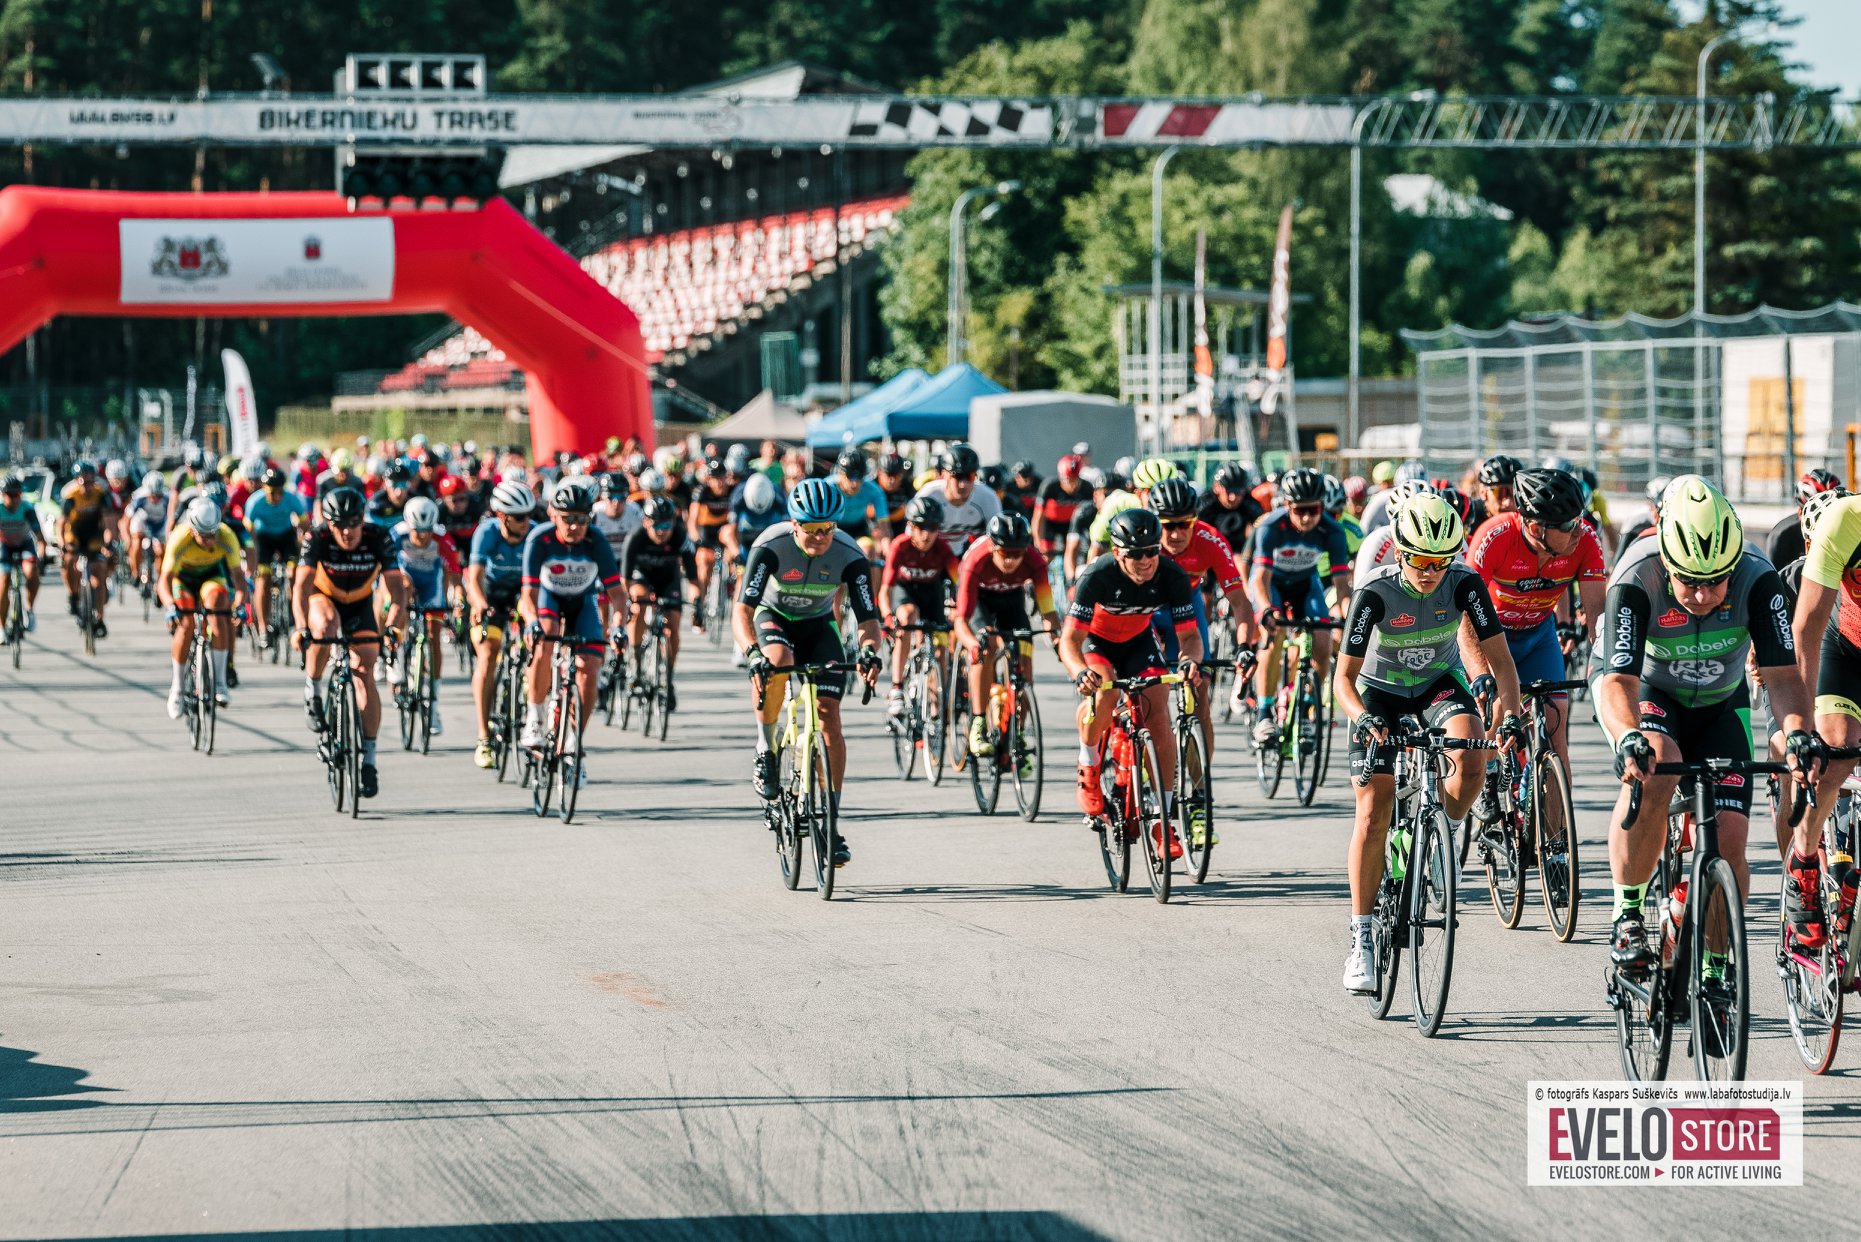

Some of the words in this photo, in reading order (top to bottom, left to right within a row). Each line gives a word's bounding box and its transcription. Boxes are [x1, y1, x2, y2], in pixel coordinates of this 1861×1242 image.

[433, 109, 518, 131] TRASE
[1354, 606, 1371, 633] Dobele
[1615, 606, 1632, 650] Dobele
[1778, 609, 1794, 651] Dobele
[1403, 630, 1452, 647] Dobele
[1675, 637, 1738, 656] Dobele
[1434, 703, 1466, 727] OSHEE
